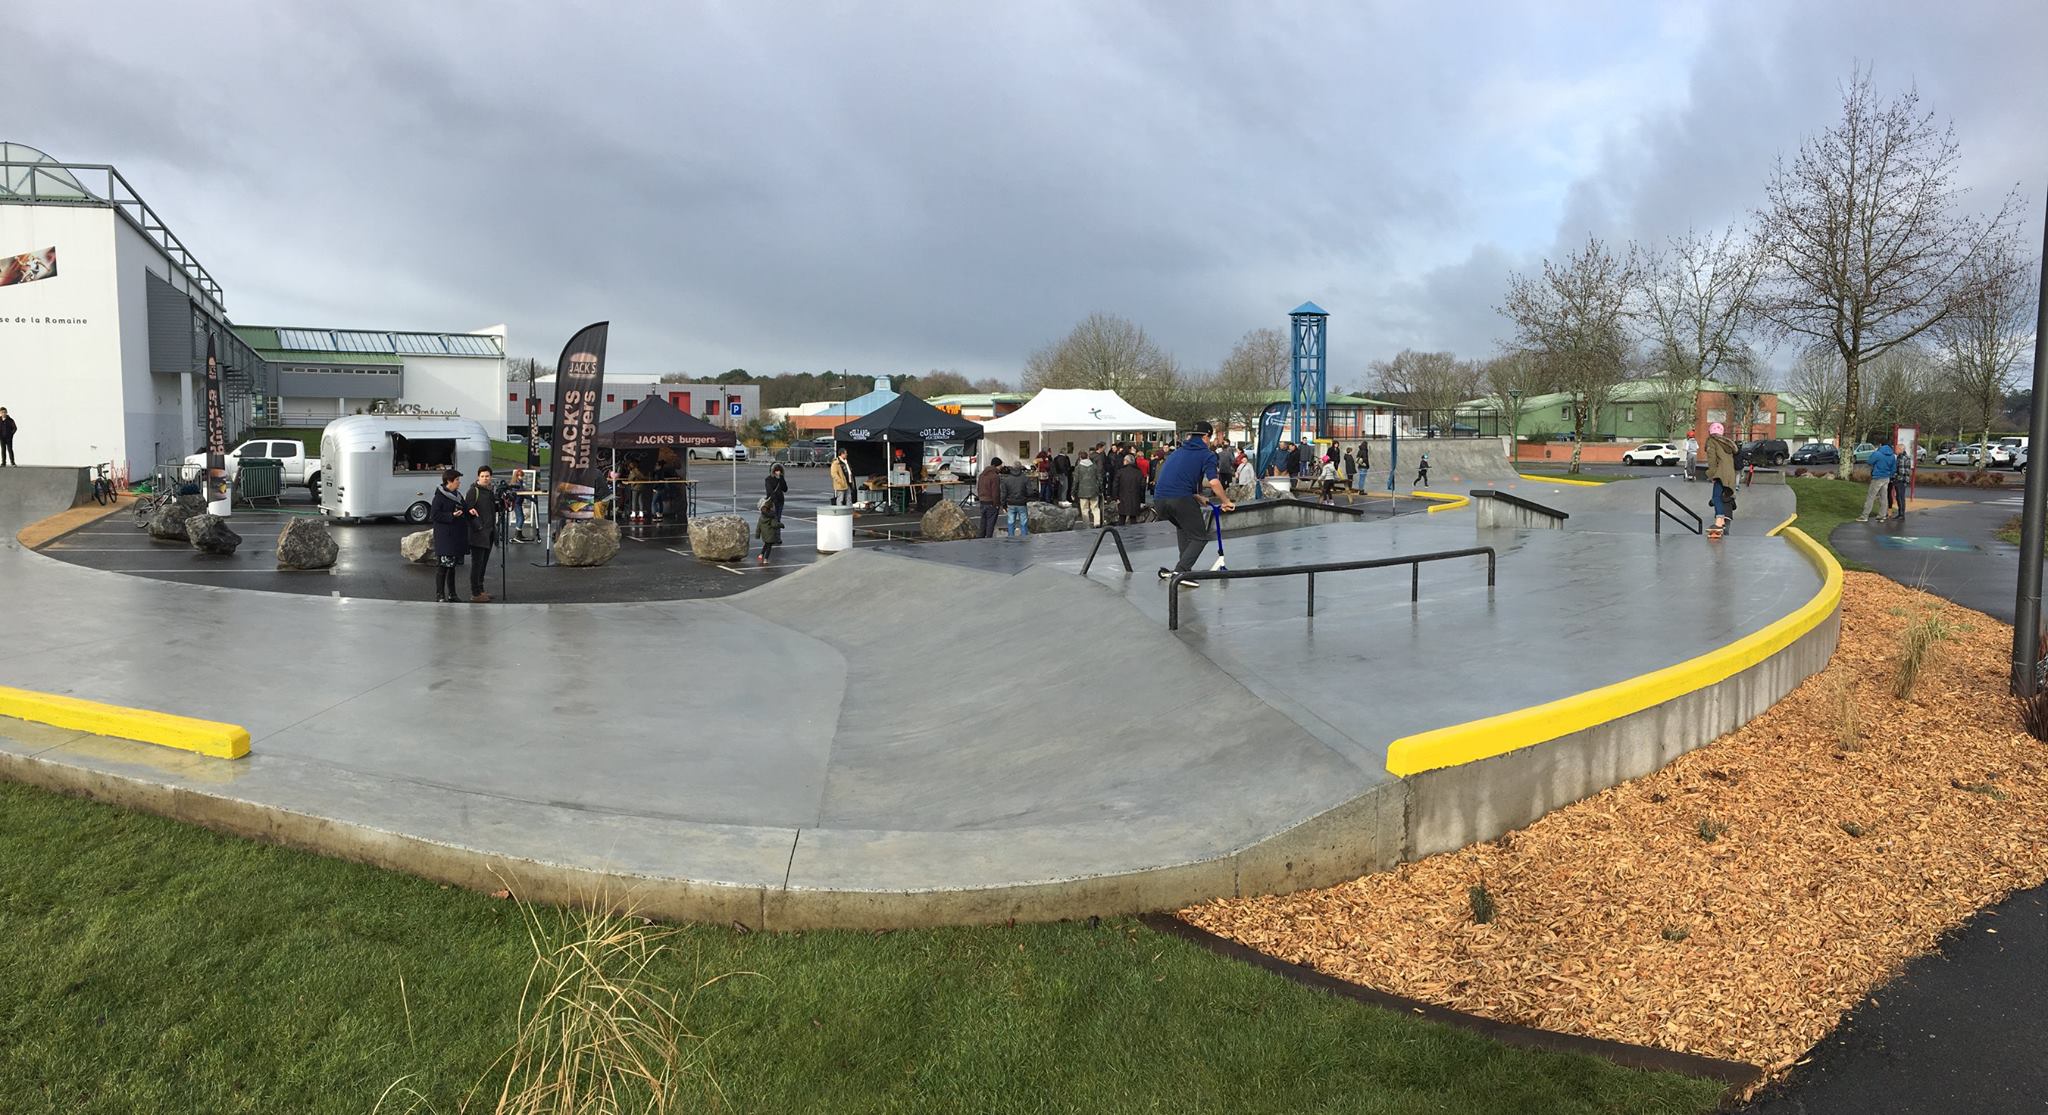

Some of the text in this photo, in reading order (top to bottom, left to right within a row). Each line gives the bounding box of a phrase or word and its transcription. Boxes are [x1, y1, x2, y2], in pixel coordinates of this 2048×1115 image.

[568, 361, 597, 374] JACK'S
[561, 390, 581, 468] JACK'S
[576, 390, 596, 469] burgers
[635, 435, 716, 446] JACK'S burgers
